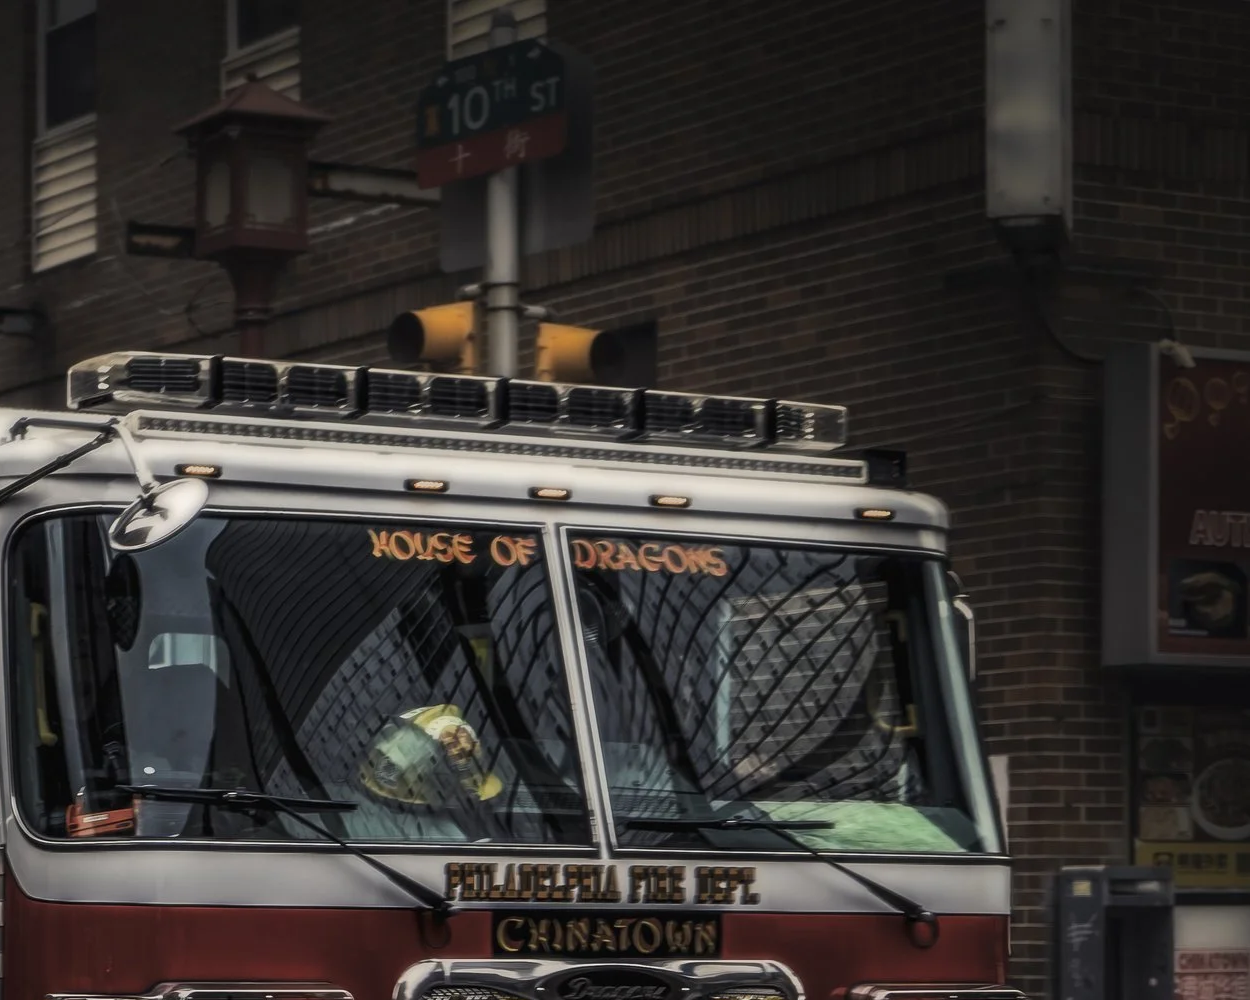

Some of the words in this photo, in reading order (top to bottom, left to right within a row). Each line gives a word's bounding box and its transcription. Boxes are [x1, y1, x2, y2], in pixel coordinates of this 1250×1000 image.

[529, 75, 562, 113] ST
[367, 528, 479, 564] HOUSE
[489, 534, 541, 568] OF
[570, 539, 729, 577] DRAGONS
[444, 861, 622, 902] PHILADELPHIA
[629, 864, 688, 904] FIRE
[694, 865, 762, 906] DEPT.
[495, 913, 720, 957] CHINATOWN
